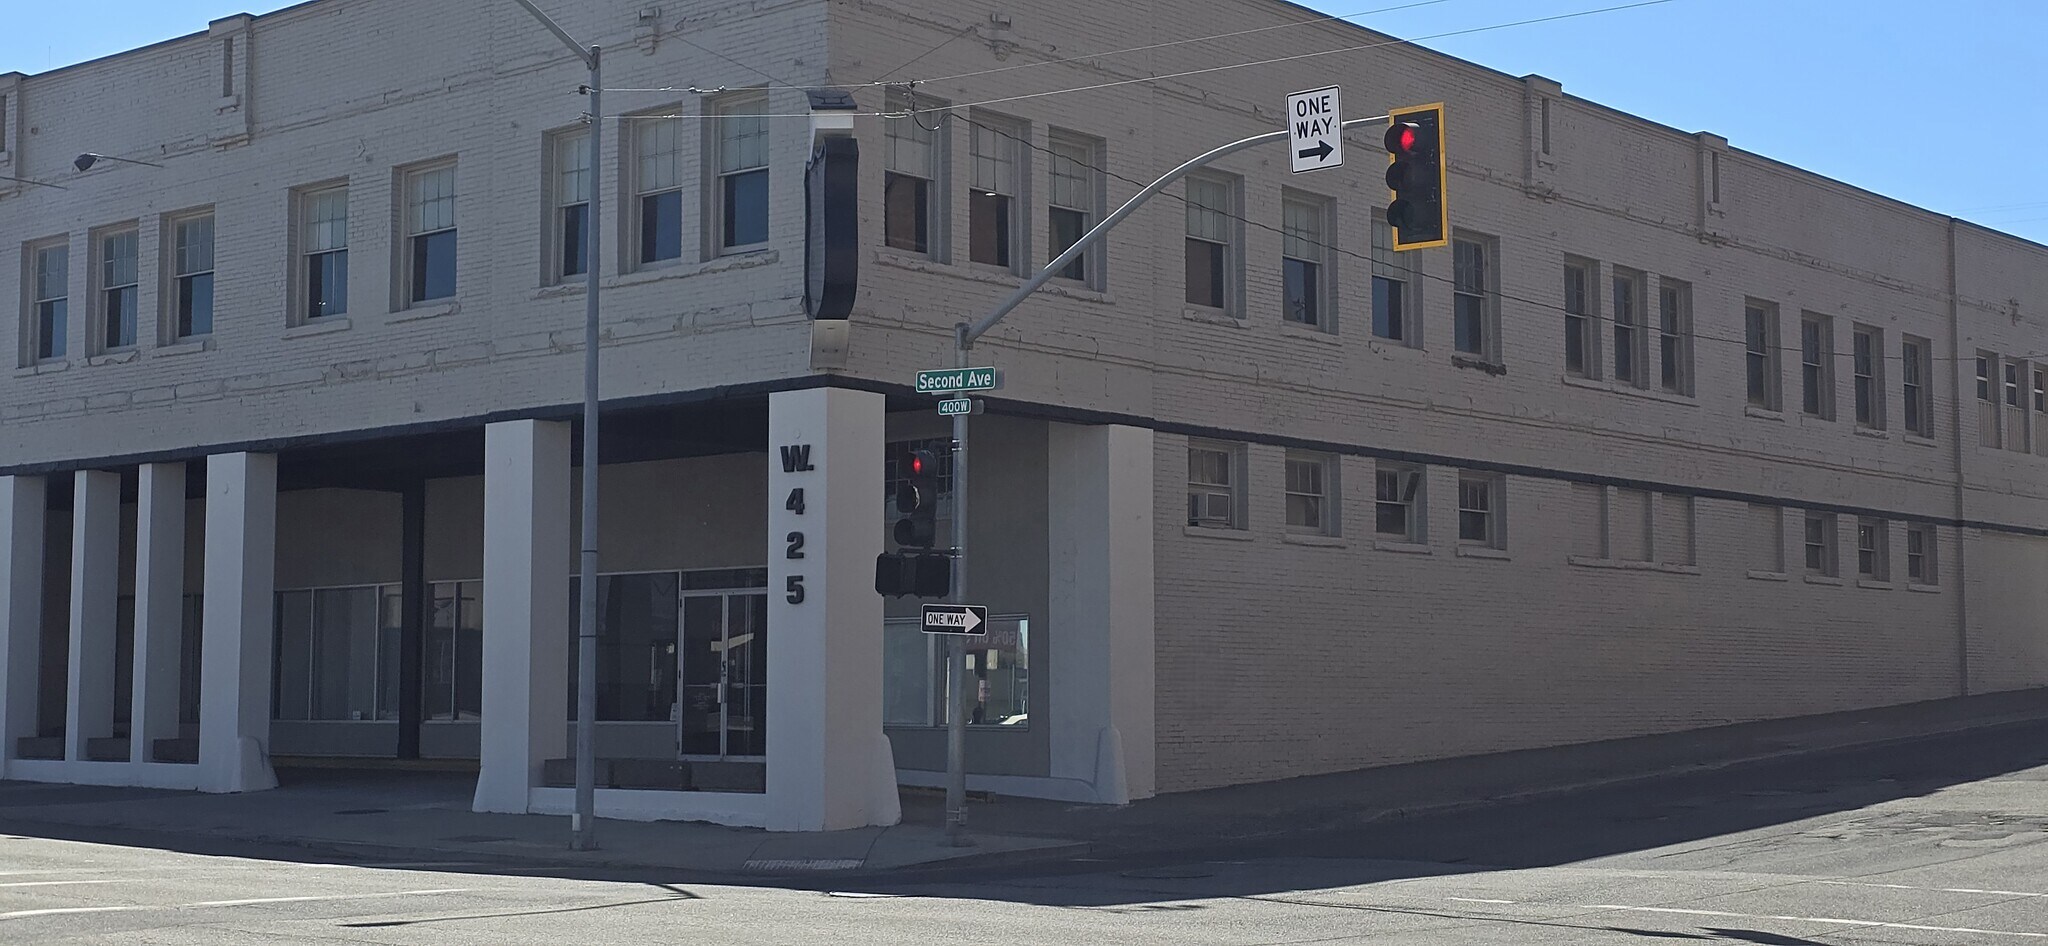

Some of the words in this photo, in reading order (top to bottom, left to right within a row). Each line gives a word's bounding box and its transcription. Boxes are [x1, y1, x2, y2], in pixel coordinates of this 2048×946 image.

[1296, 95, 1331, 117] ONE
[1296, 116, 1333, 139] WAY
[919, 372, 963, 390] Second
[967, 371, 991, 387] Ave
[941, 401, 968, 412] 400W
[927, 613, 944, 625] ONE
[946, 614, 966, 625] WAY
